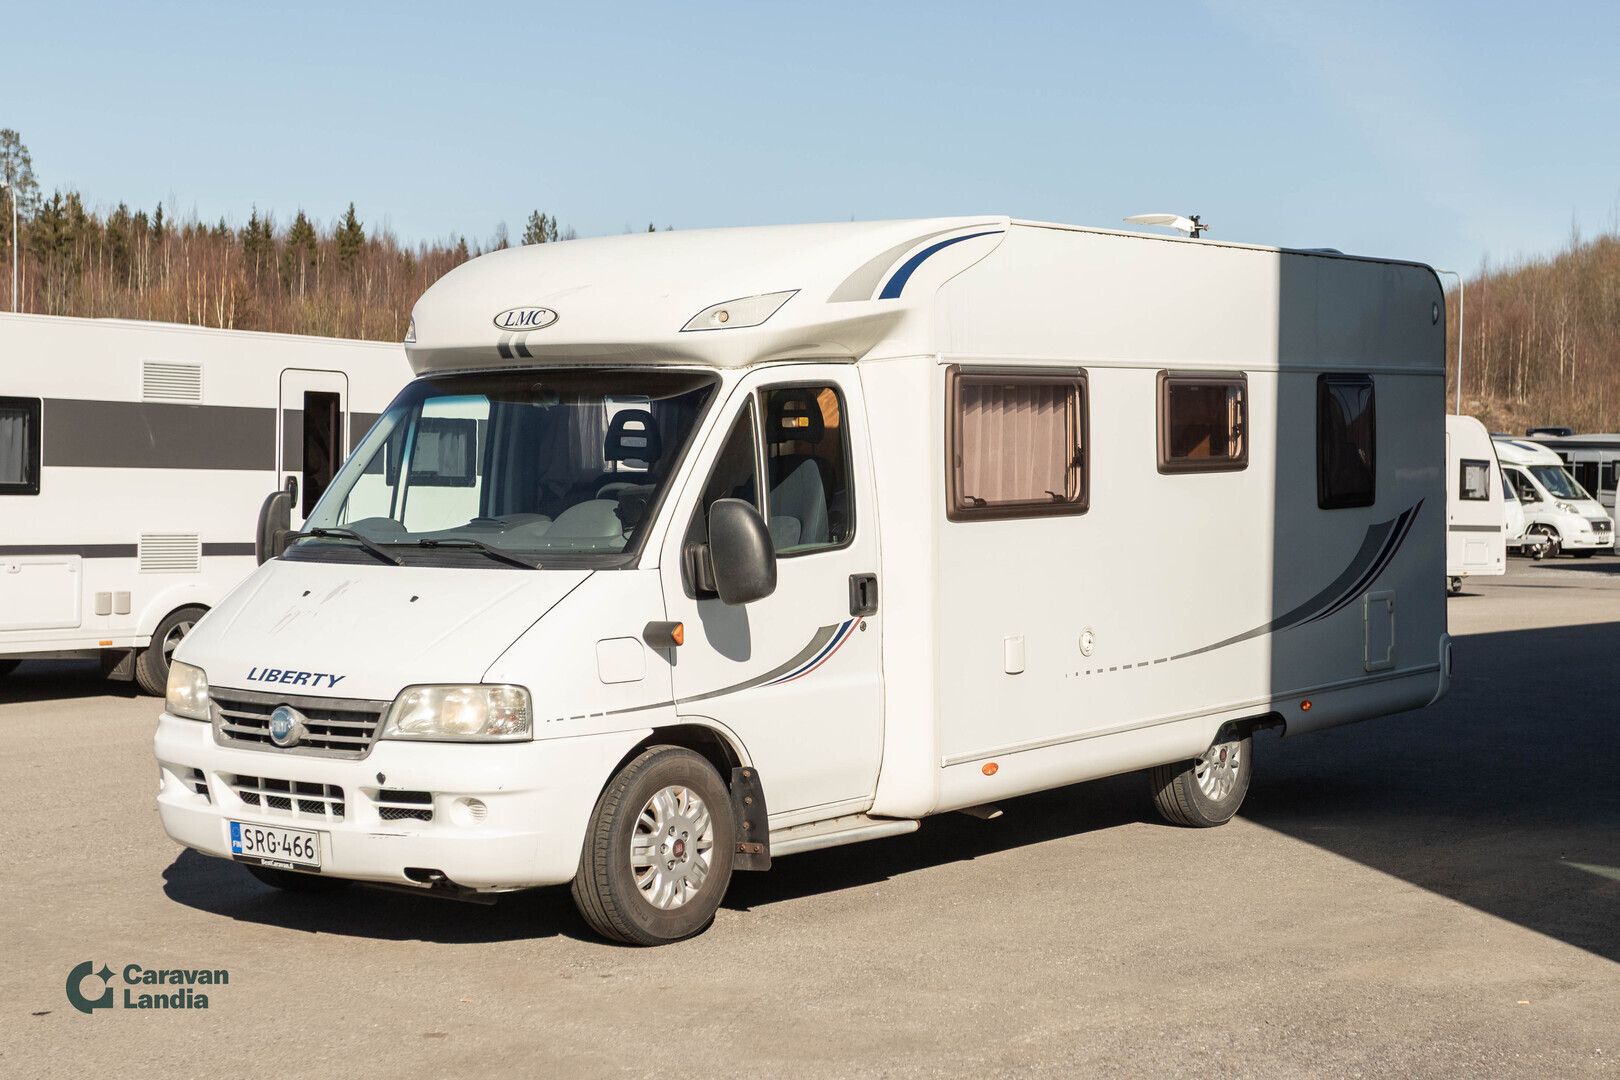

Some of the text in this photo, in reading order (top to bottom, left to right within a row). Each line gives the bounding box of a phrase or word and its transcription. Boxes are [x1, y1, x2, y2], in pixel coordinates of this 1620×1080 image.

[504, 309, 546, 327] LMC
[246, 667, 346, 688] LIBERTY
[244, 828, 314, 860] SRG-466
